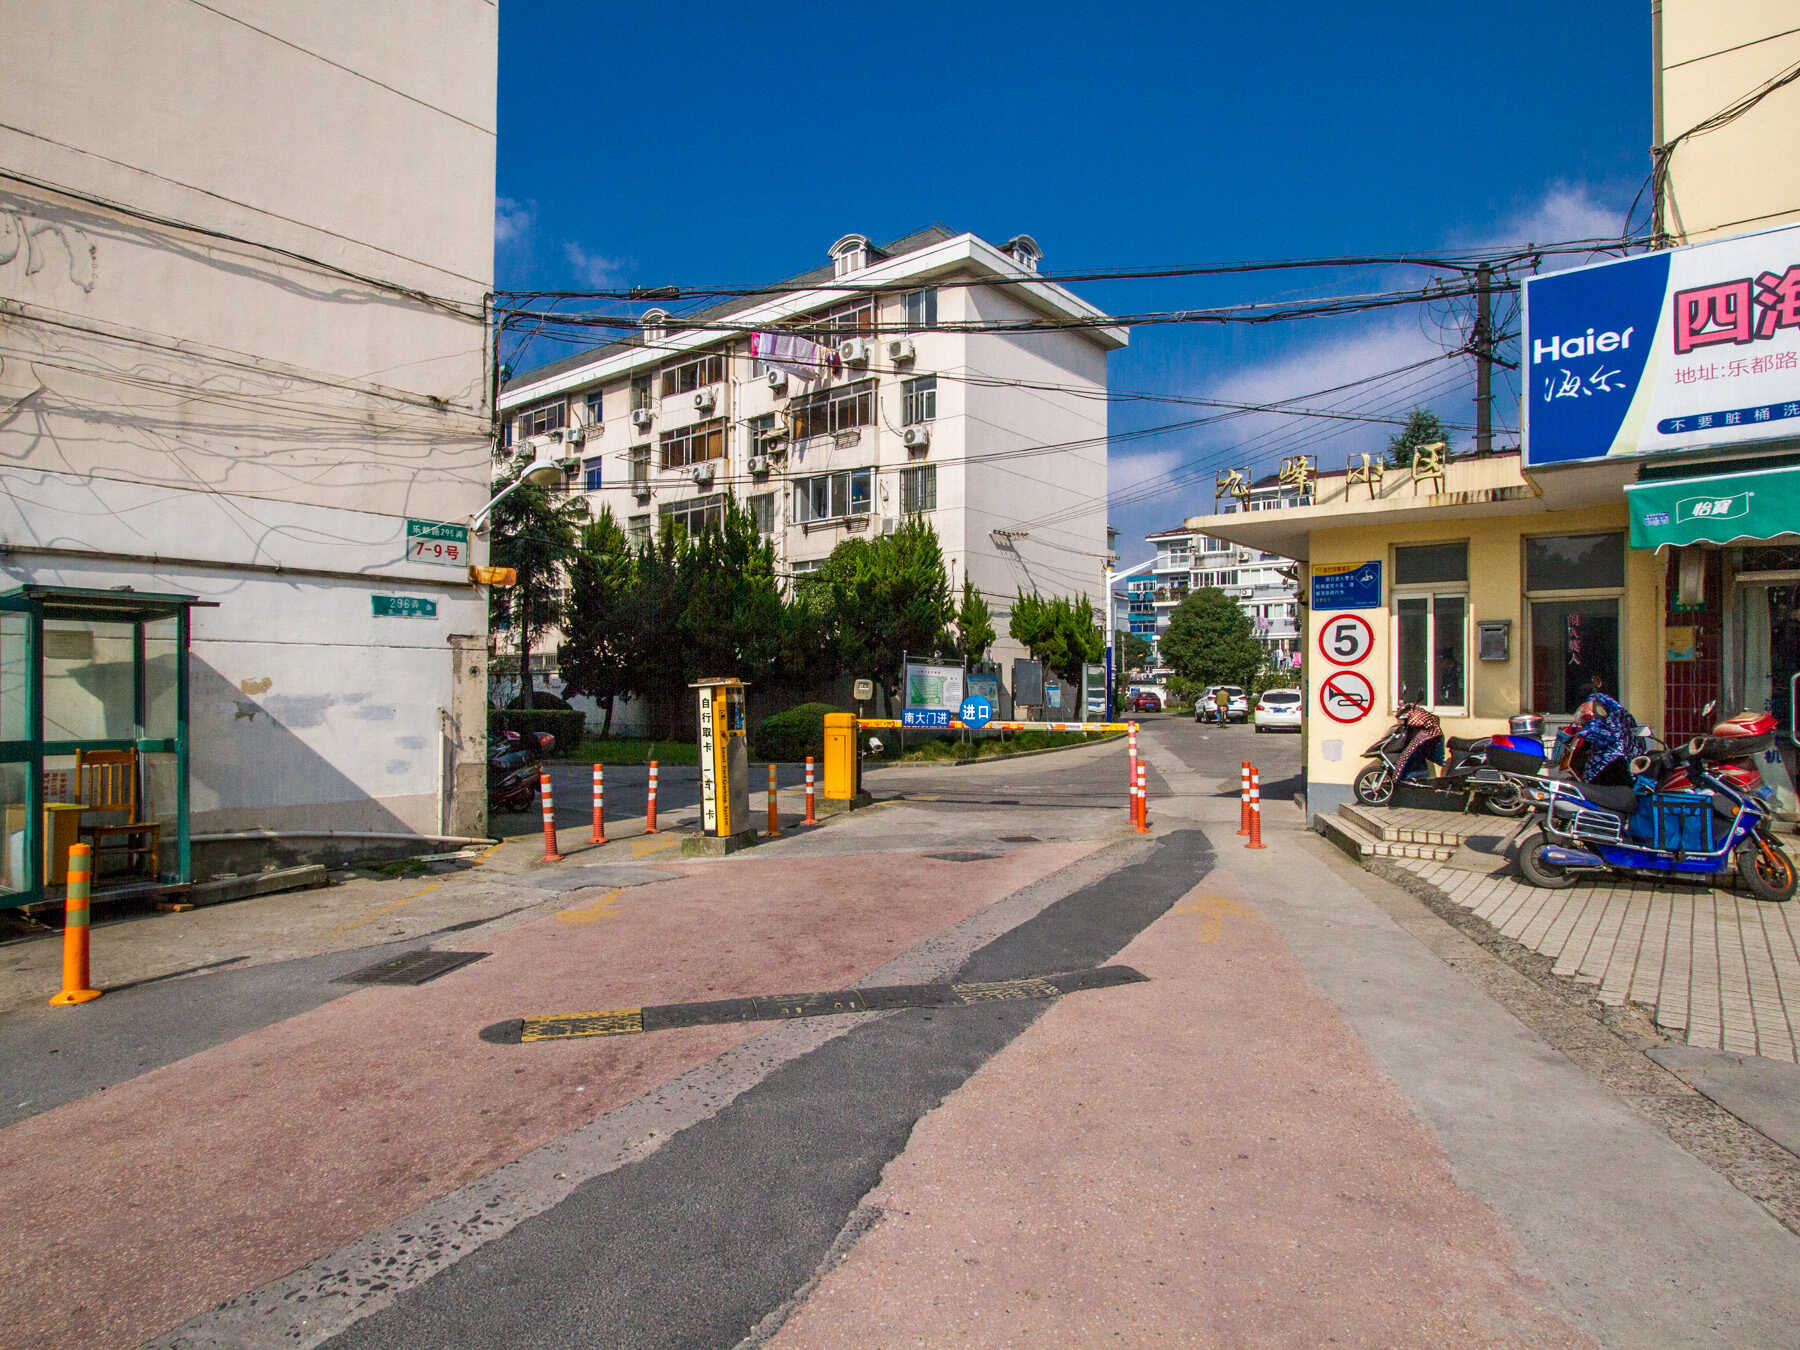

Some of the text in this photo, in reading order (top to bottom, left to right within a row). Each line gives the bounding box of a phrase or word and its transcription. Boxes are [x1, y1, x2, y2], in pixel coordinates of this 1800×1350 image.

[1533, 325, 1634, 364] Haier
[1334, 624, 1359, 656] 5
[904, 712, 948, 725] 南大门进
[962, 703, 989, 720] 进口
